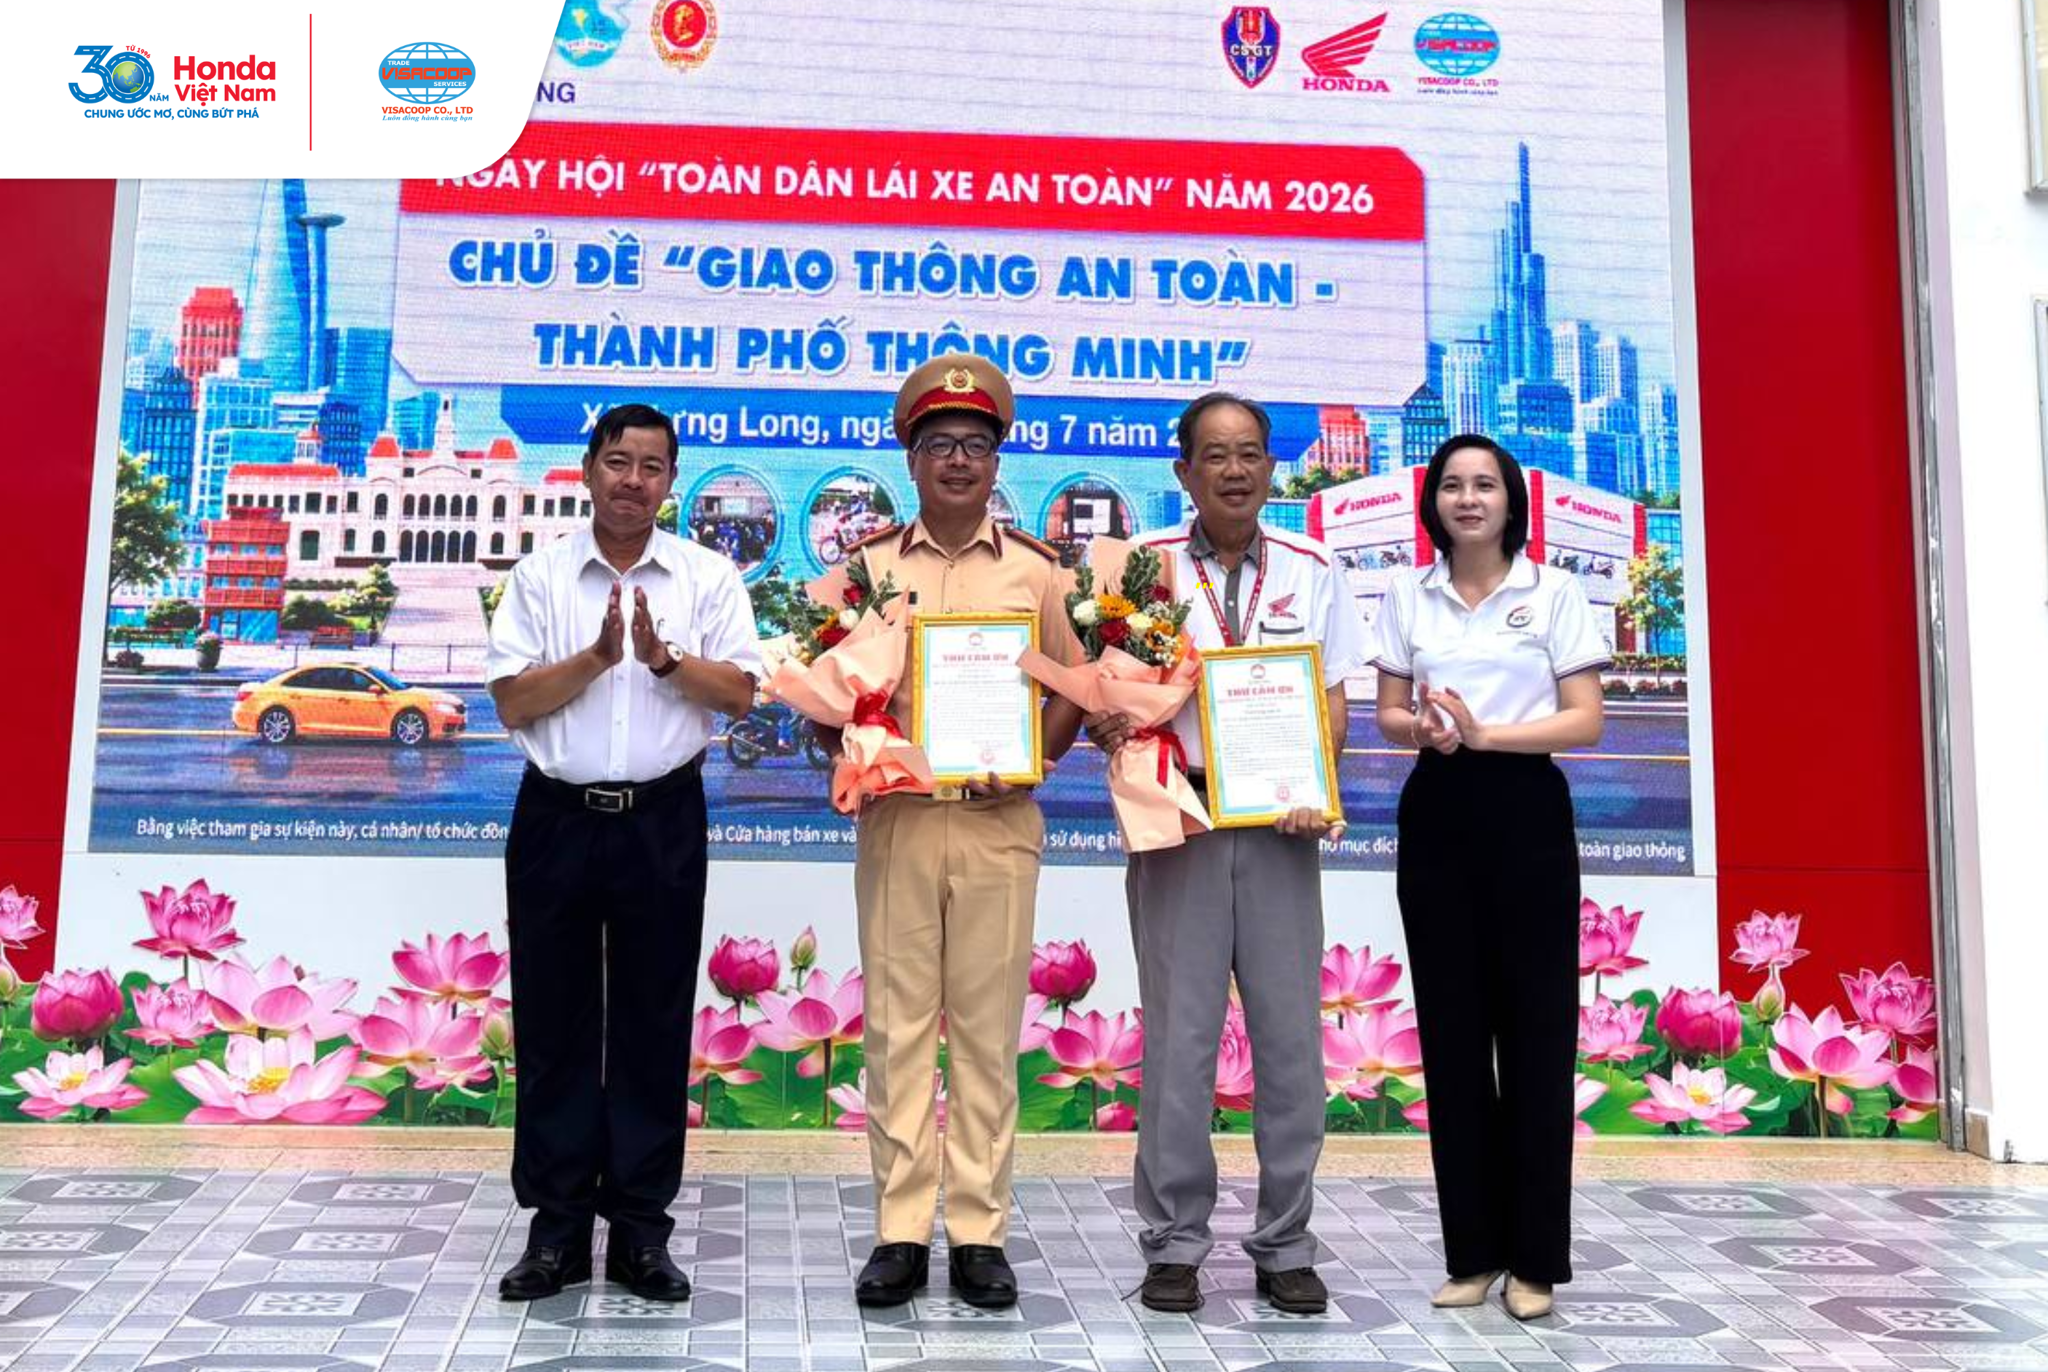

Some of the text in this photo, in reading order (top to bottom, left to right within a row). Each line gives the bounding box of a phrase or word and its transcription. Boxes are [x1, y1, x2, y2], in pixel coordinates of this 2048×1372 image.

[1230, 44, 1273, 56] CSGT
[537, 82, 576, 103] NG
[1303, 78, 1391, 93] HONDA
[436, 153, 547, 189] GÀY
[558, 154, 625, 199] HỘI
[774, 160, 853, 198] DÂN
[867, 163, 917, 200] LÁI
[930, 170, 974, 201] XE
[985, 173, 1040, 205] AN
[1186, 174, 1273, 211] NĂM
[1284, 181, 1375, 215] 2026
[448, 228, 556, 285] CHỦ
[573, 228, 642, 288] ĐỀ
[853, 240, 1038, 296] THÔNG
[1057, 257, 1132, 300] AN
[1151, 249, 1294, 305] TOÀN
[533, 312, 716, 369] THÀNH
[736, 315, 851, 371] PHỐ
[739, 406, 830, 444] Long,
[840, 411, 897, 446] ngà
[1059, 415, 1077, 444] 7
[1088, 415, 1157, 447] năm
[1350, 492, 1403, 512] HONDA
[1572, 501, 1622, 524] HONDA
[177, 817, 206, 840] việc
[208, 820, 246, 836] tham
[250, 821, 270, 841] gia
[274, 822, 291, 840] sự
[295, 819, 325, 840] kiện
[361, 820, 377, 838] cá
[443, 821, 477, 839] chức
[481, 821, 509, 839] đồn
[725, 825, 752, 842] Cửa
[756, 825, 790, 846] hàng
[793, 825, 820, 843] bán
[823, 830, 838, 843] xe
[1049, 829, 1068, 846] sử
[1069, 830, 1105, 851] dụng
[1341, 840, 1370, 856] mục
[1579, 841, 1610, 857] toàn
[1613, 842, 1642, 861] giao
[1645, 841, 1686, 862] thông
